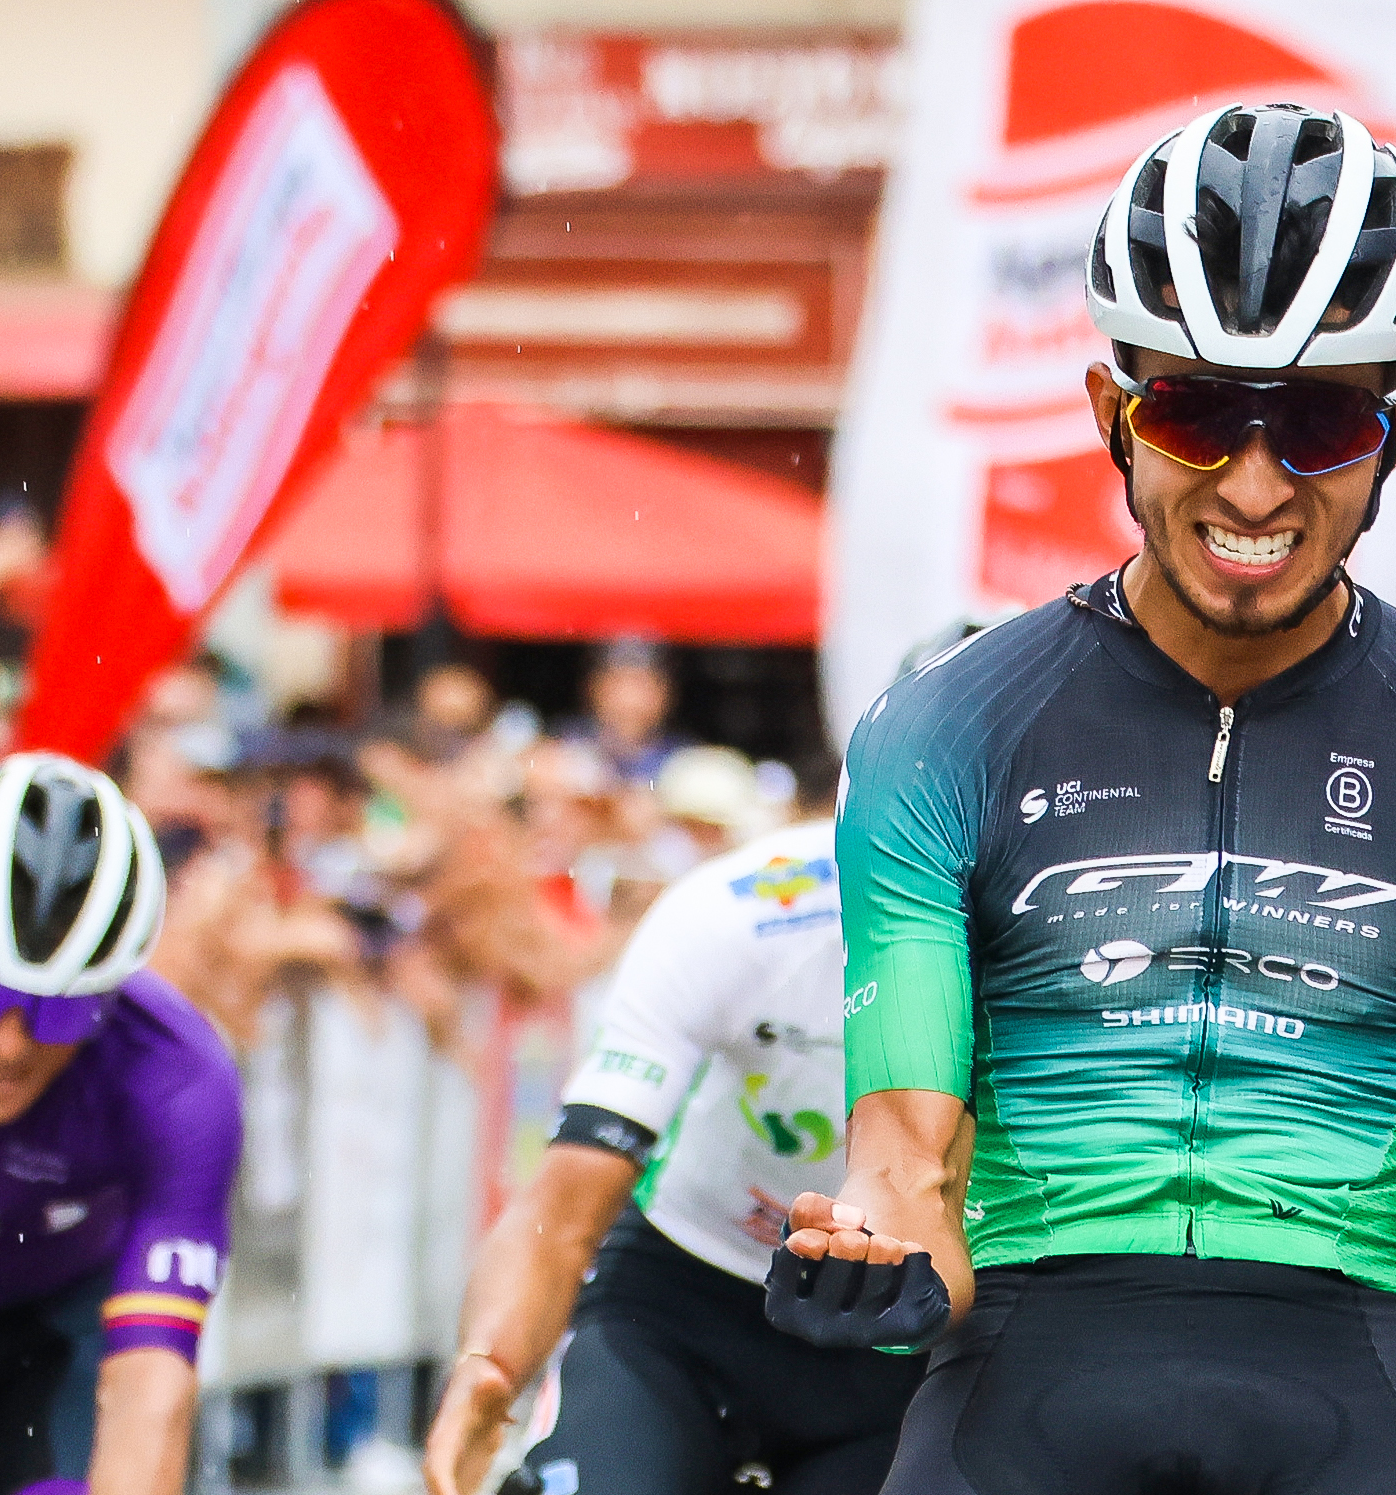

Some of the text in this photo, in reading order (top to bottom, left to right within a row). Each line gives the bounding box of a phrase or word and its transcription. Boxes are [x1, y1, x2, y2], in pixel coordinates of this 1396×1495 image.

[1329, 752, 1375, 769] Empresa
[1055, 786, 1141, 806] CONTINENTAL
[1056, 780, 1082, 795] UCI
[1054, 801, 1086, 818] TEAM
[1324, 823, 1373, 842] Certificada
[1047, 896, 1381, 939] made for WINNERS
[1101, 1001, 1306, 1040] SHIMANO
